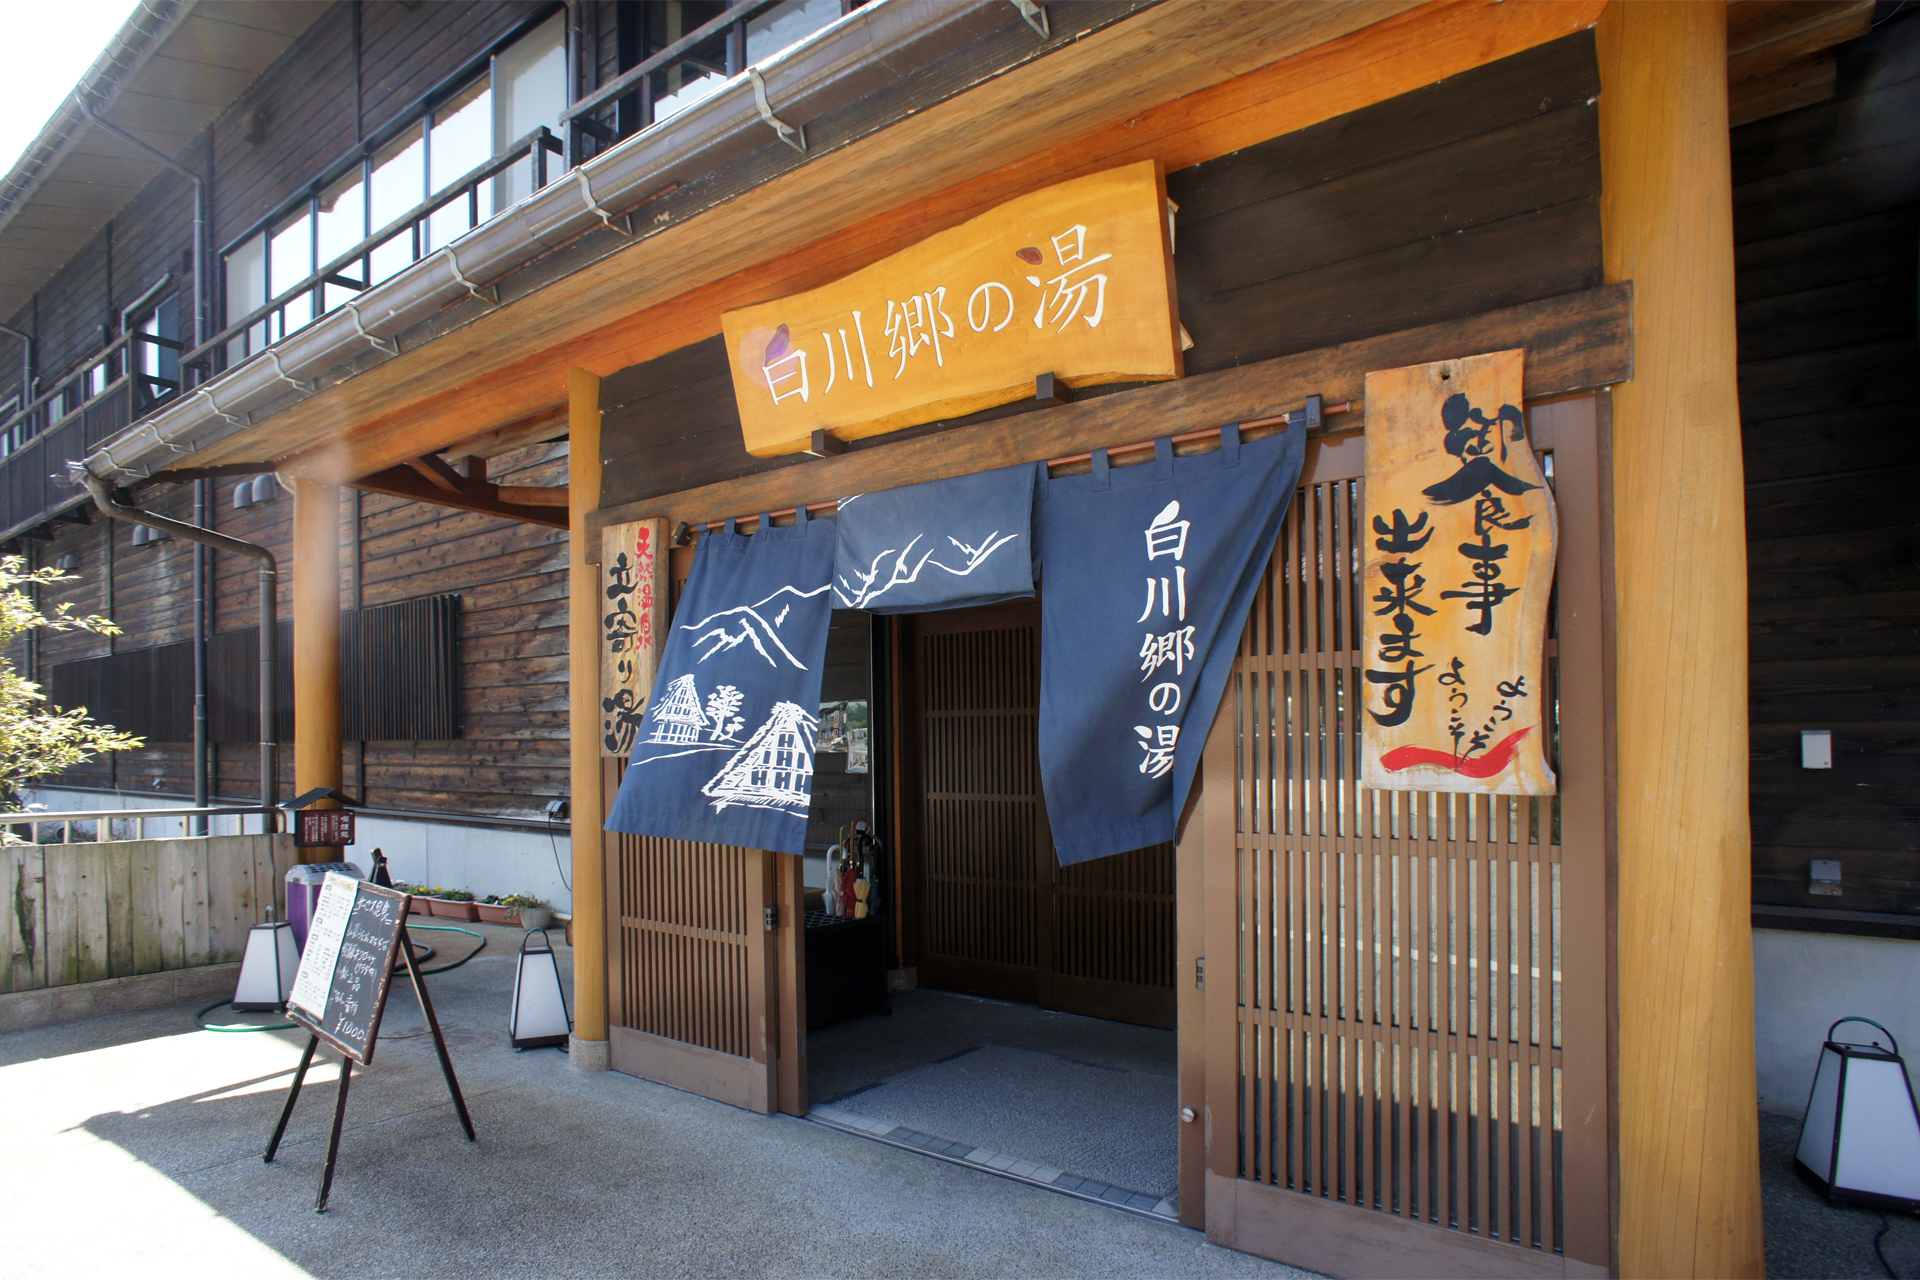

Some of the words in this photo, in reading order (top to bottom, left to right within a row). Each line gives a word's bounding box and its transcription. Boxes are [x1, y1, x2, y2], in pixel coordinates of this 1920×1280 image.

[761, 223, 1113, 407] 白川郷の湯
[634, 526, 655, 651] 天然温泉
[1422, 392, 1544, 636] 御食事
[603, 552, 646, 755] 立寄り湯
[1134, 500, 1196, 780] 白川郷の湯
[1364, 508, 1438, 727] 出来ます
[1438, 657, 1468, 773] ようこそ
[1461, 675, 1528, 768] ようこそ
